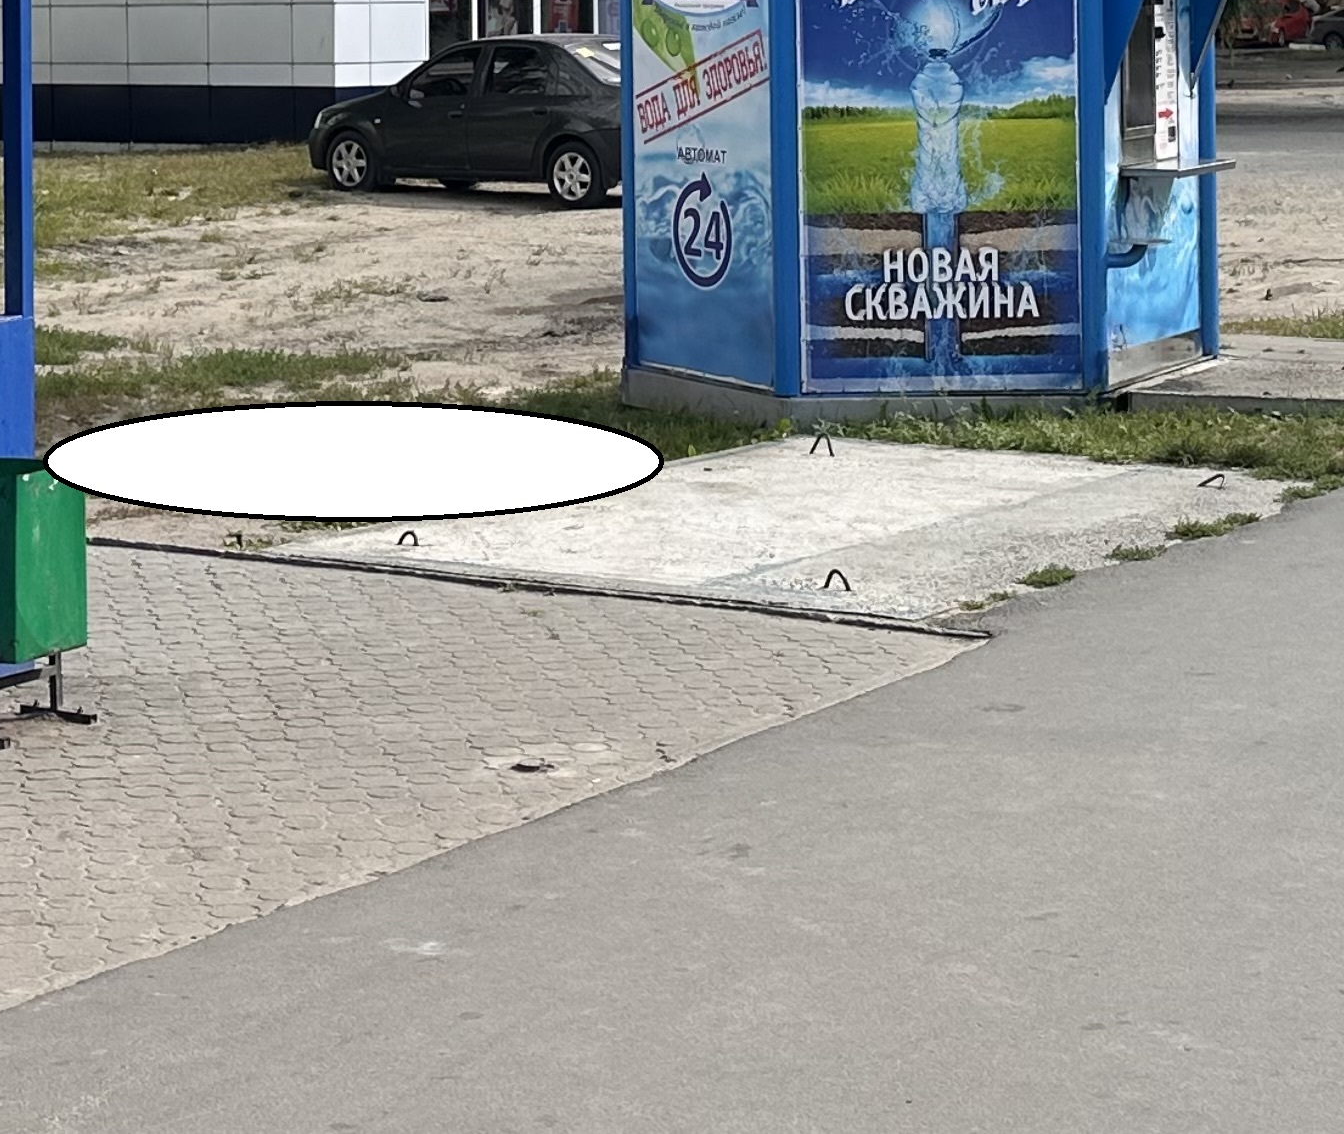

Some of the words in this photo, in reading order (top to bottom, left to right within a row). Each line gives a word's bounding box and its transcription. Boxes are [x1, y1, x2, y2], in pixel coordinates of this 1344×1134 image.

[637, 91, 671, 134] ВОДА
[672, 75, 701, 120] ДЛЯ
[678, 146, 728, 164] АВТОМАТ
[683, 207, 725, 260] 24
[883, 247, 999, 283] НОВАЯ
[844, 282, 1041, 321] СКВАЖИНА
